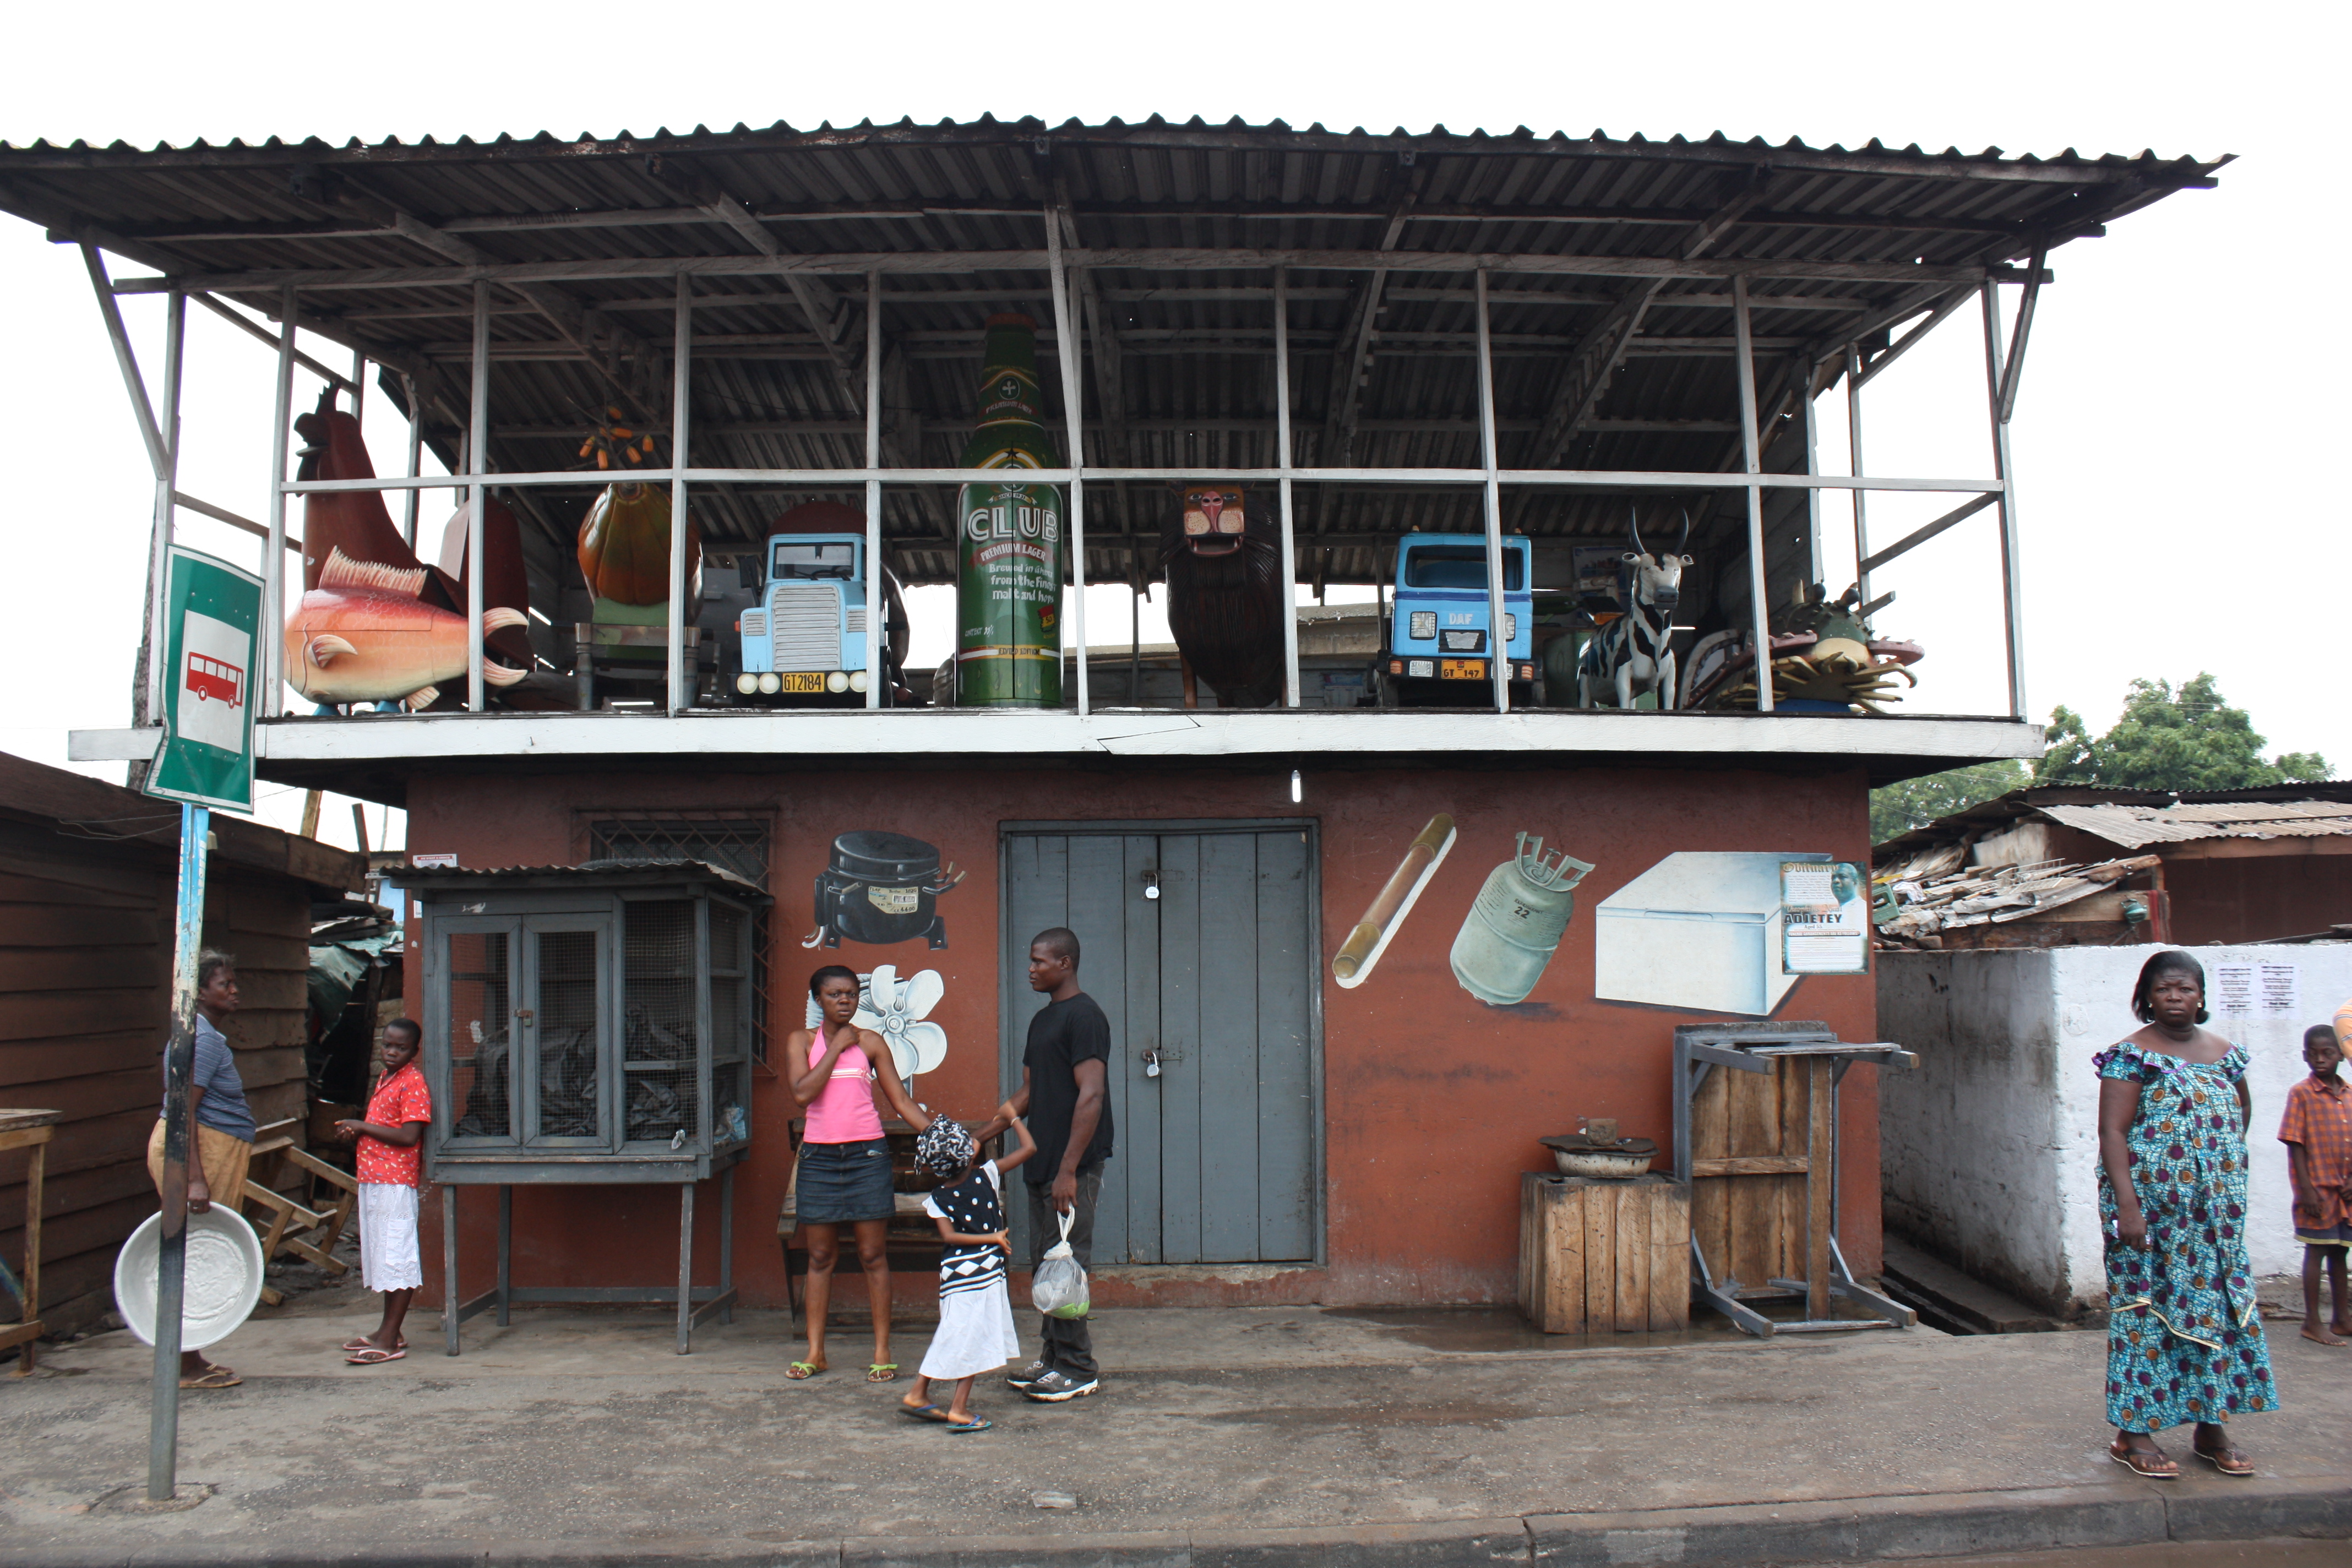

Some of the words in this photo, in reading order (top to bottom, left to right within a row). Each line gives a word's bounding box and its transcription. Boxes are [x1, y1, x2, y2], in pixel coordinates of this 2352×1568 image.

[967, 507, 1059, 542] CLUB
[980, 543, 1020, 562] PREMIUM
[1022, 544, 1046, 562] LAGER
[989, 563, 1023, 573] Brewed
[1025, 563, 1033, 573] in
[991, 575, 1017, 585] from
[1017, 575, 1035, 587] the
[992, 588, 1020, 600] malt
[1021, 589, 1036, 601] and
[1449, 613, 1473, 625] DAF
[1443, 668, 1455, 677] GT
[1463, 669, 1480, 678] 147
[1783, 862, 1839, 874] Obituary
[1513, 906, 1530, 919] 22
